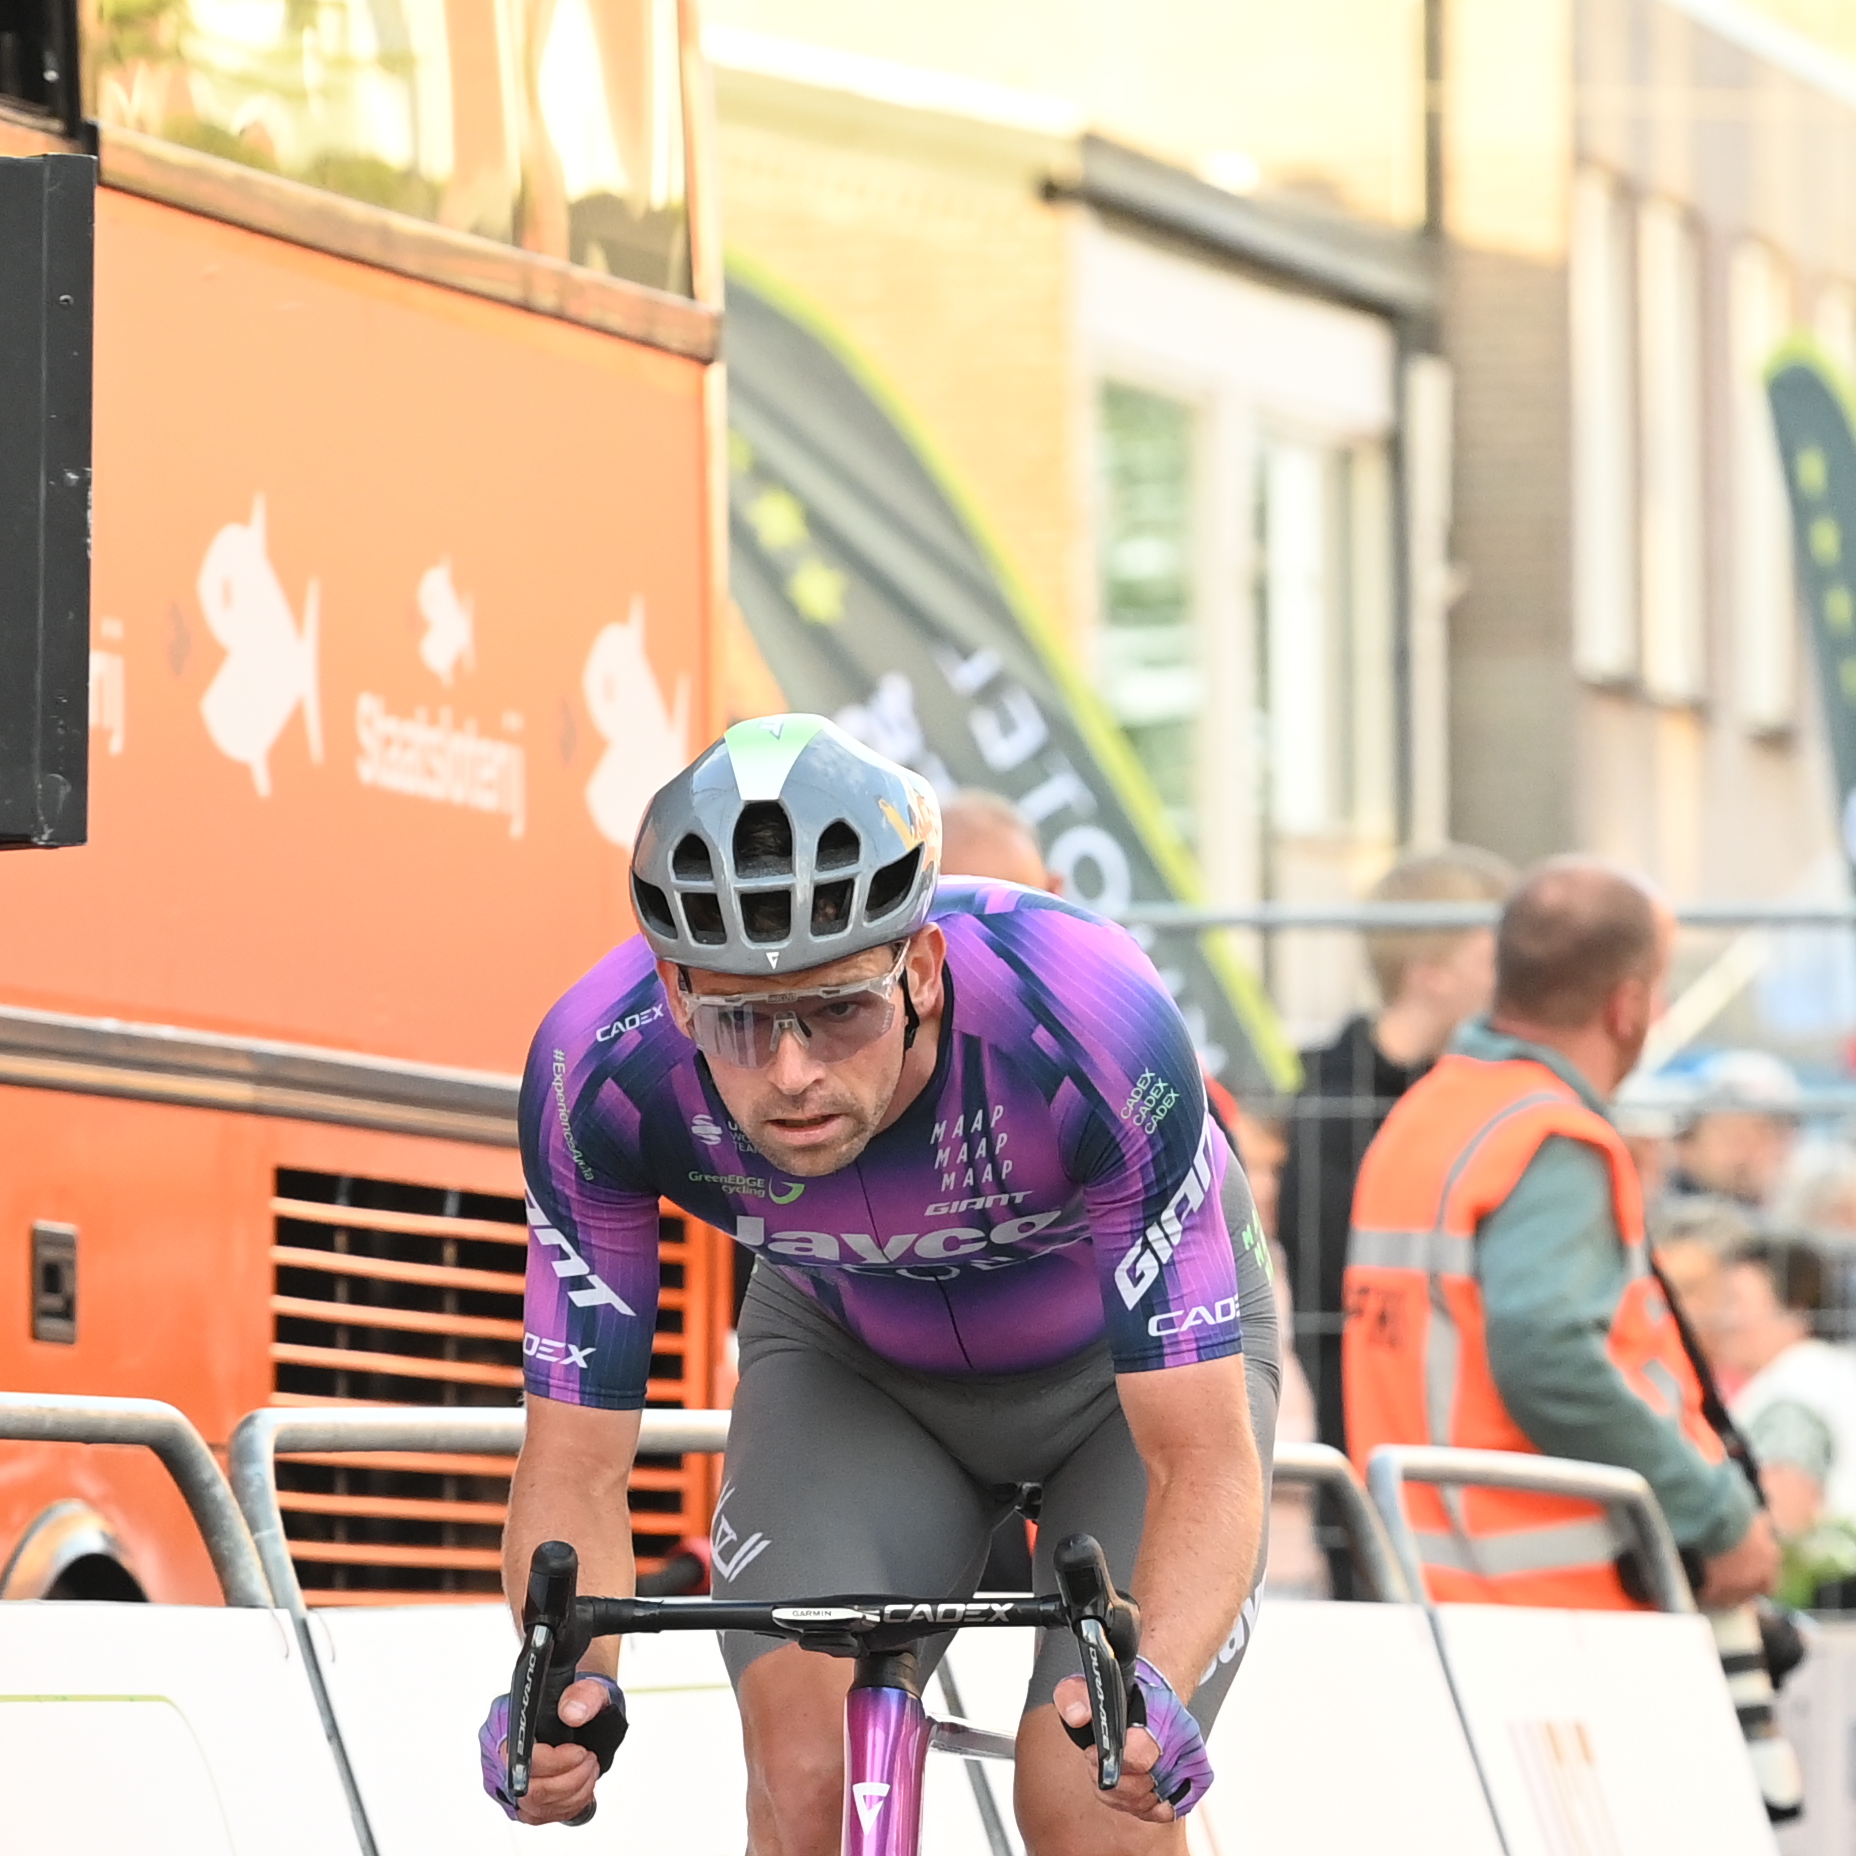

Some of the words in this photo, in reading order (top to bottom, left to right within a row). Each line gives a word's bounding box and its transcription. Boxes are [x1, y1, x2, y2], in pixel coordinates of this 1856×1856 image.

[595, 1003, 665, 1043] CADEX
[1120, 1066, 1156, 1120] CADEX
[1132, 1076, 1169, 1127] CADEX
[1144, 1087, 1180, 1135] CADEX
[929, 1104, 1005, 1145] MAAP
[933, 1132, 1009, 1170] MAAP
[687, 1170, 767, 1188] GreenEDGE
[720, 1184, 766, 1198] cycling
[940, 1159, 1014, 1192] MAAP
[924, 1190, 1034, 1217] GIANT
[734, 1210, 1062, 1264] Jayco
[1147, 1293, 1241, 1338] CAD
[791, 1609, 833, 1618] GARMIN
[882, 1603, 1015, 1623] CADEX
